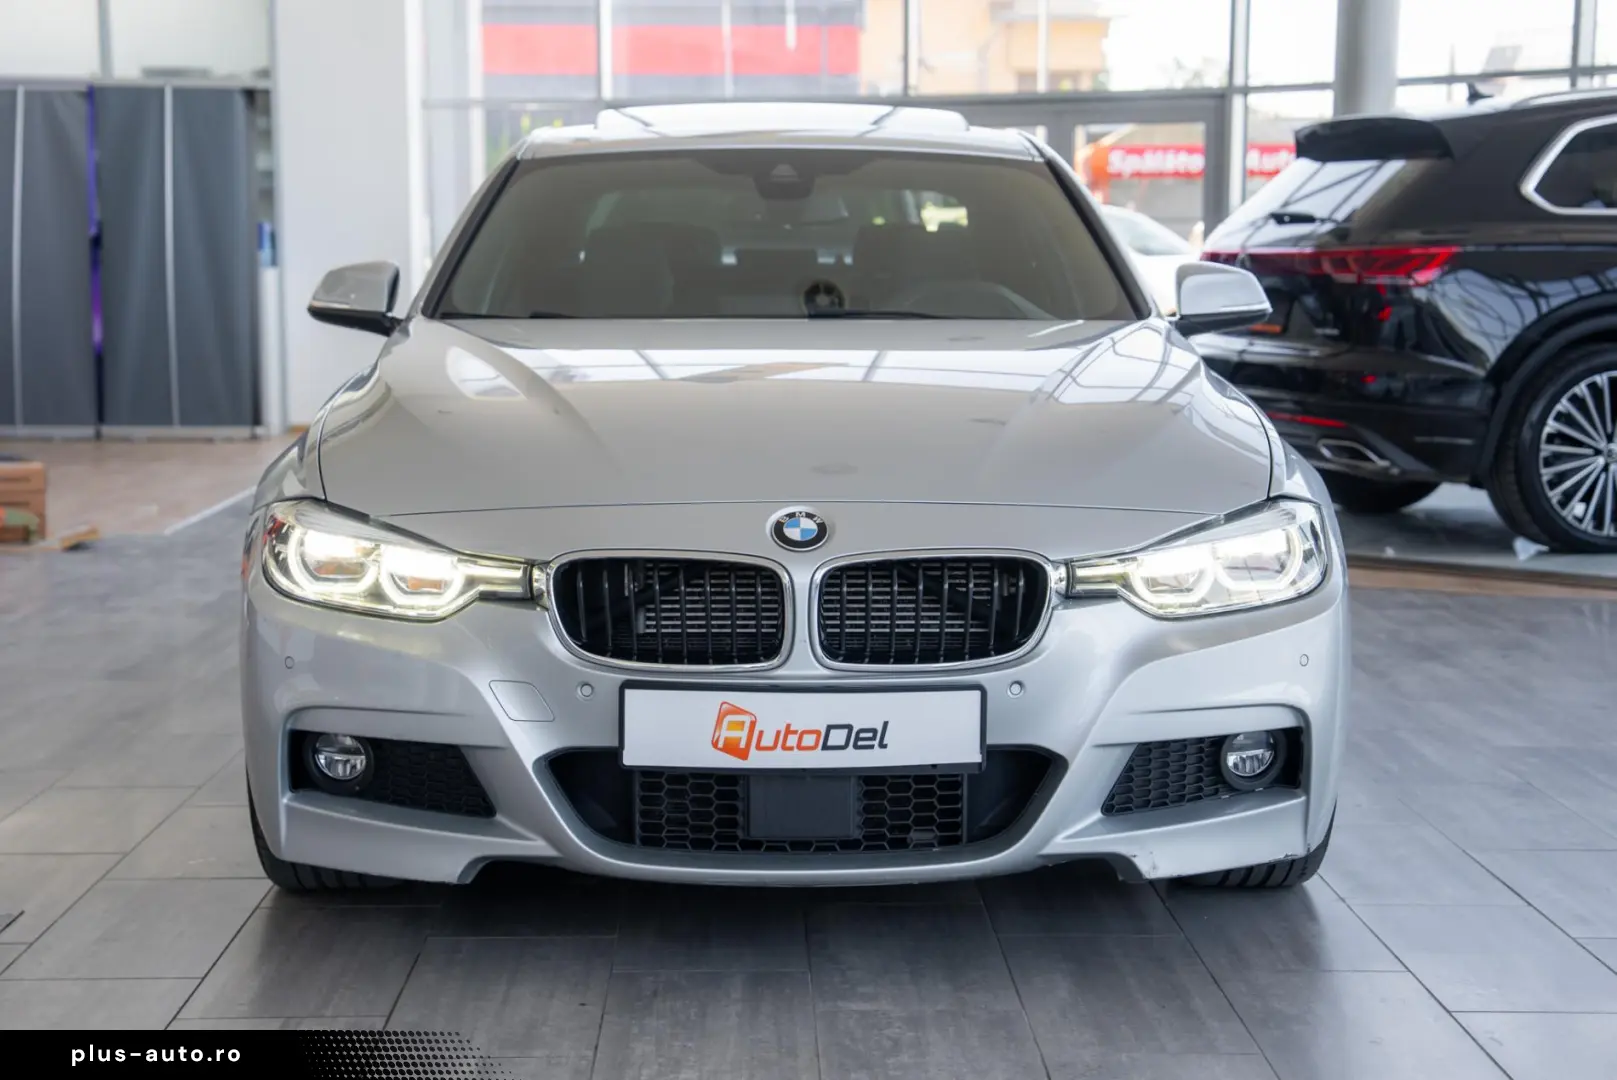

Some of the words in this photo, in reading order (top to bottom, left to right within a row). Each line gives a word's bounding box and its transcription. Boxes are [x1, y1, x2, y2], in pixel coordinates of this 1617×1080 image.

[1107, 148, 1204, 178] Spălăto
[778, 511, 824, 524] BMW
[717, 713, 889, 752] AutoDel
